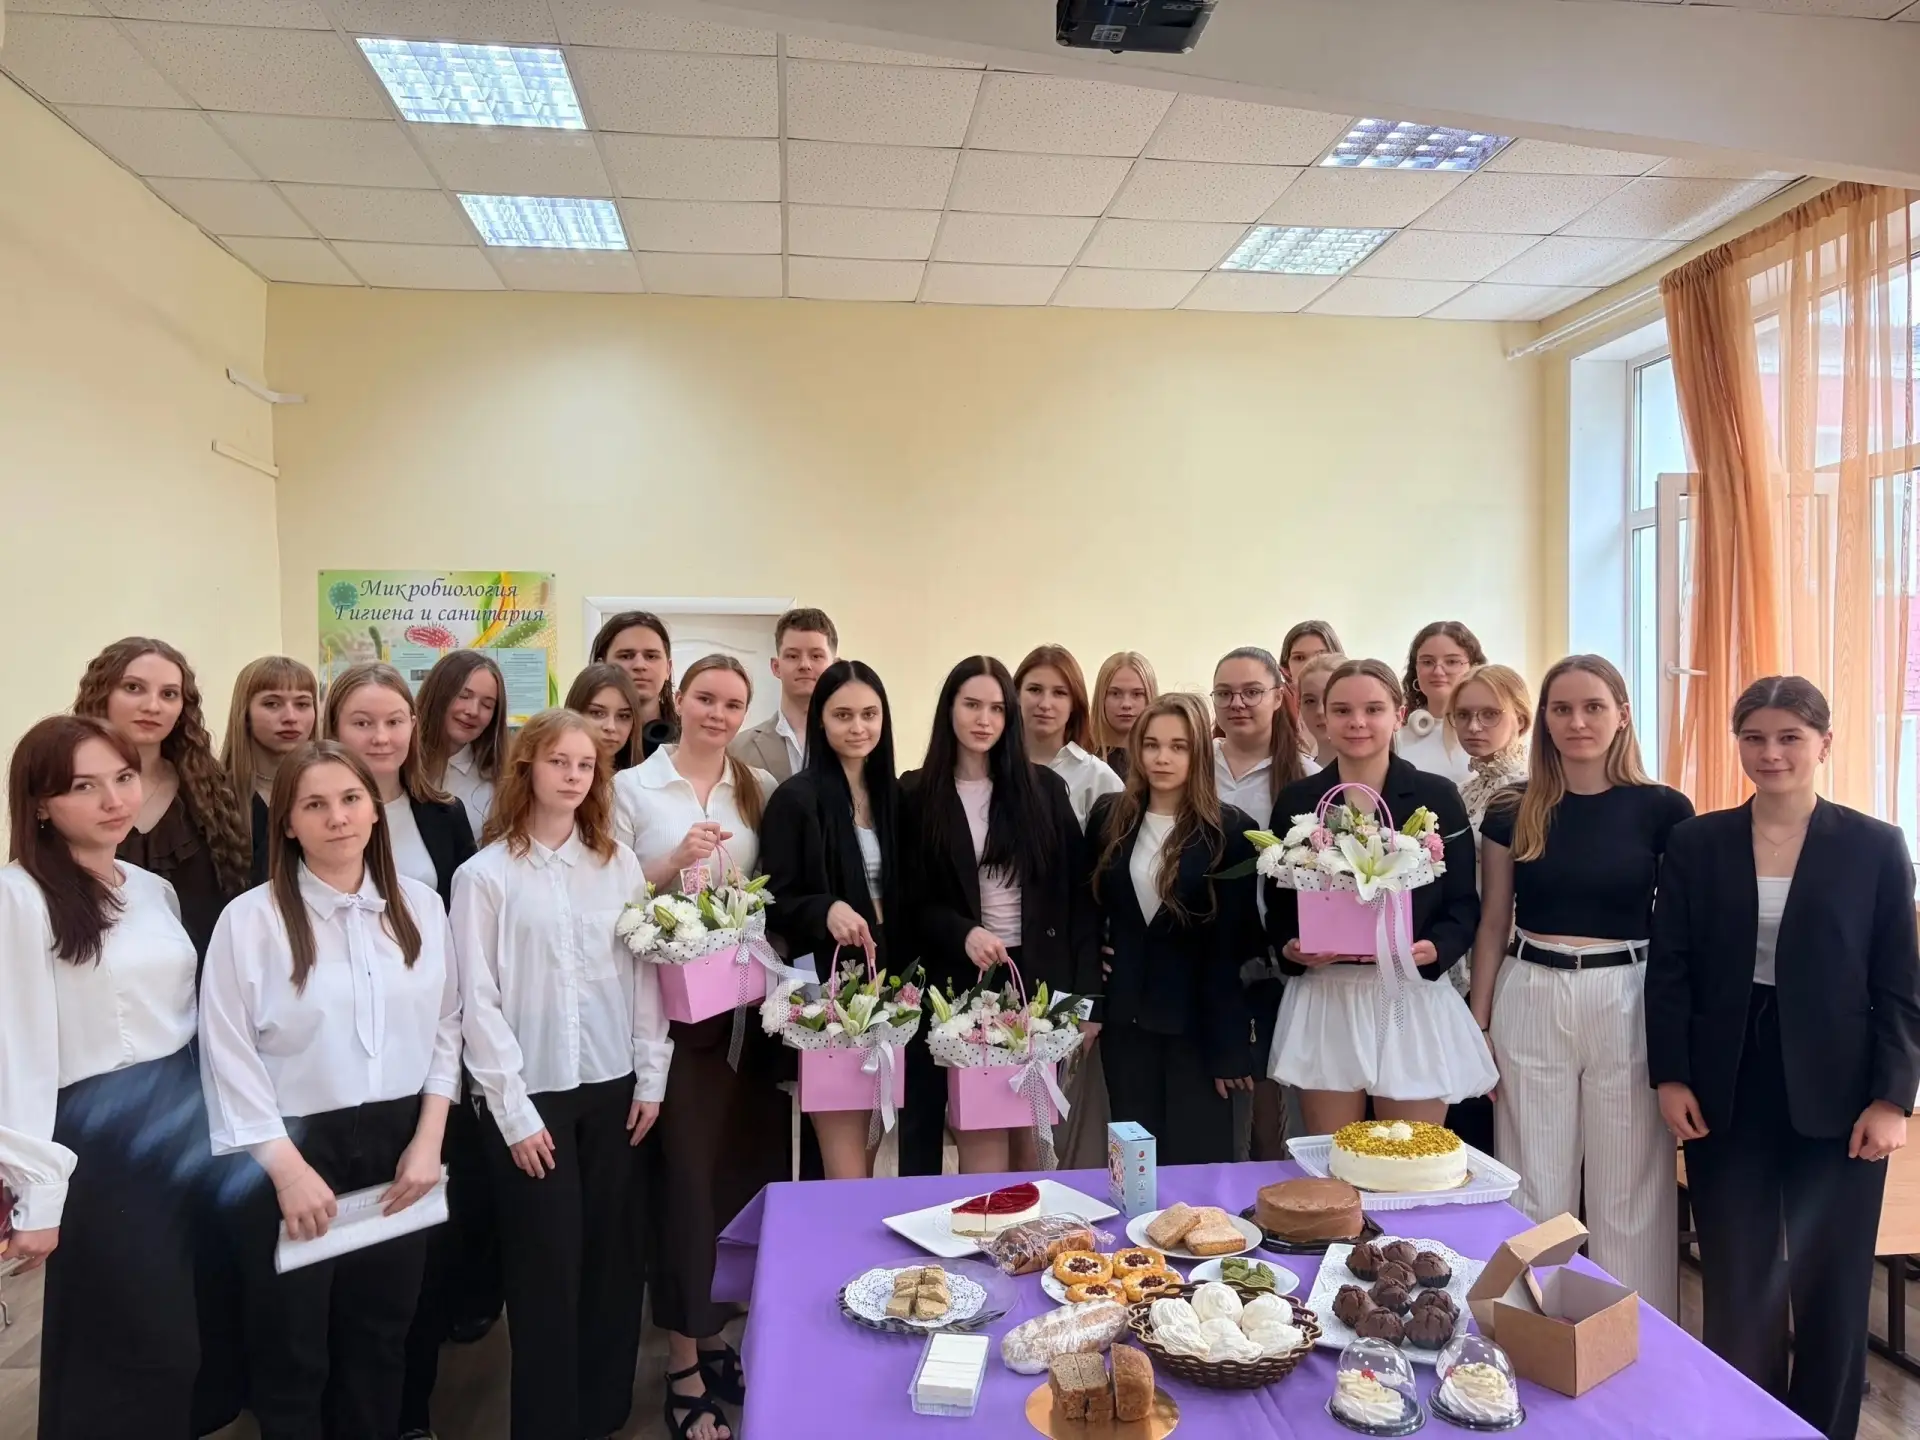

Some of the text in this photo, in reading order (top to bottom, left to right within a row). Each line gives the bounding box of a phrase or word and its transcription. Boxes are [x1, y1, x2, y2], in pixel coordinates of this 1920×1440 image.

[359, 577, 518, 602] Микробиология
[334, 604, 545, 627] Гигиена и санитария
